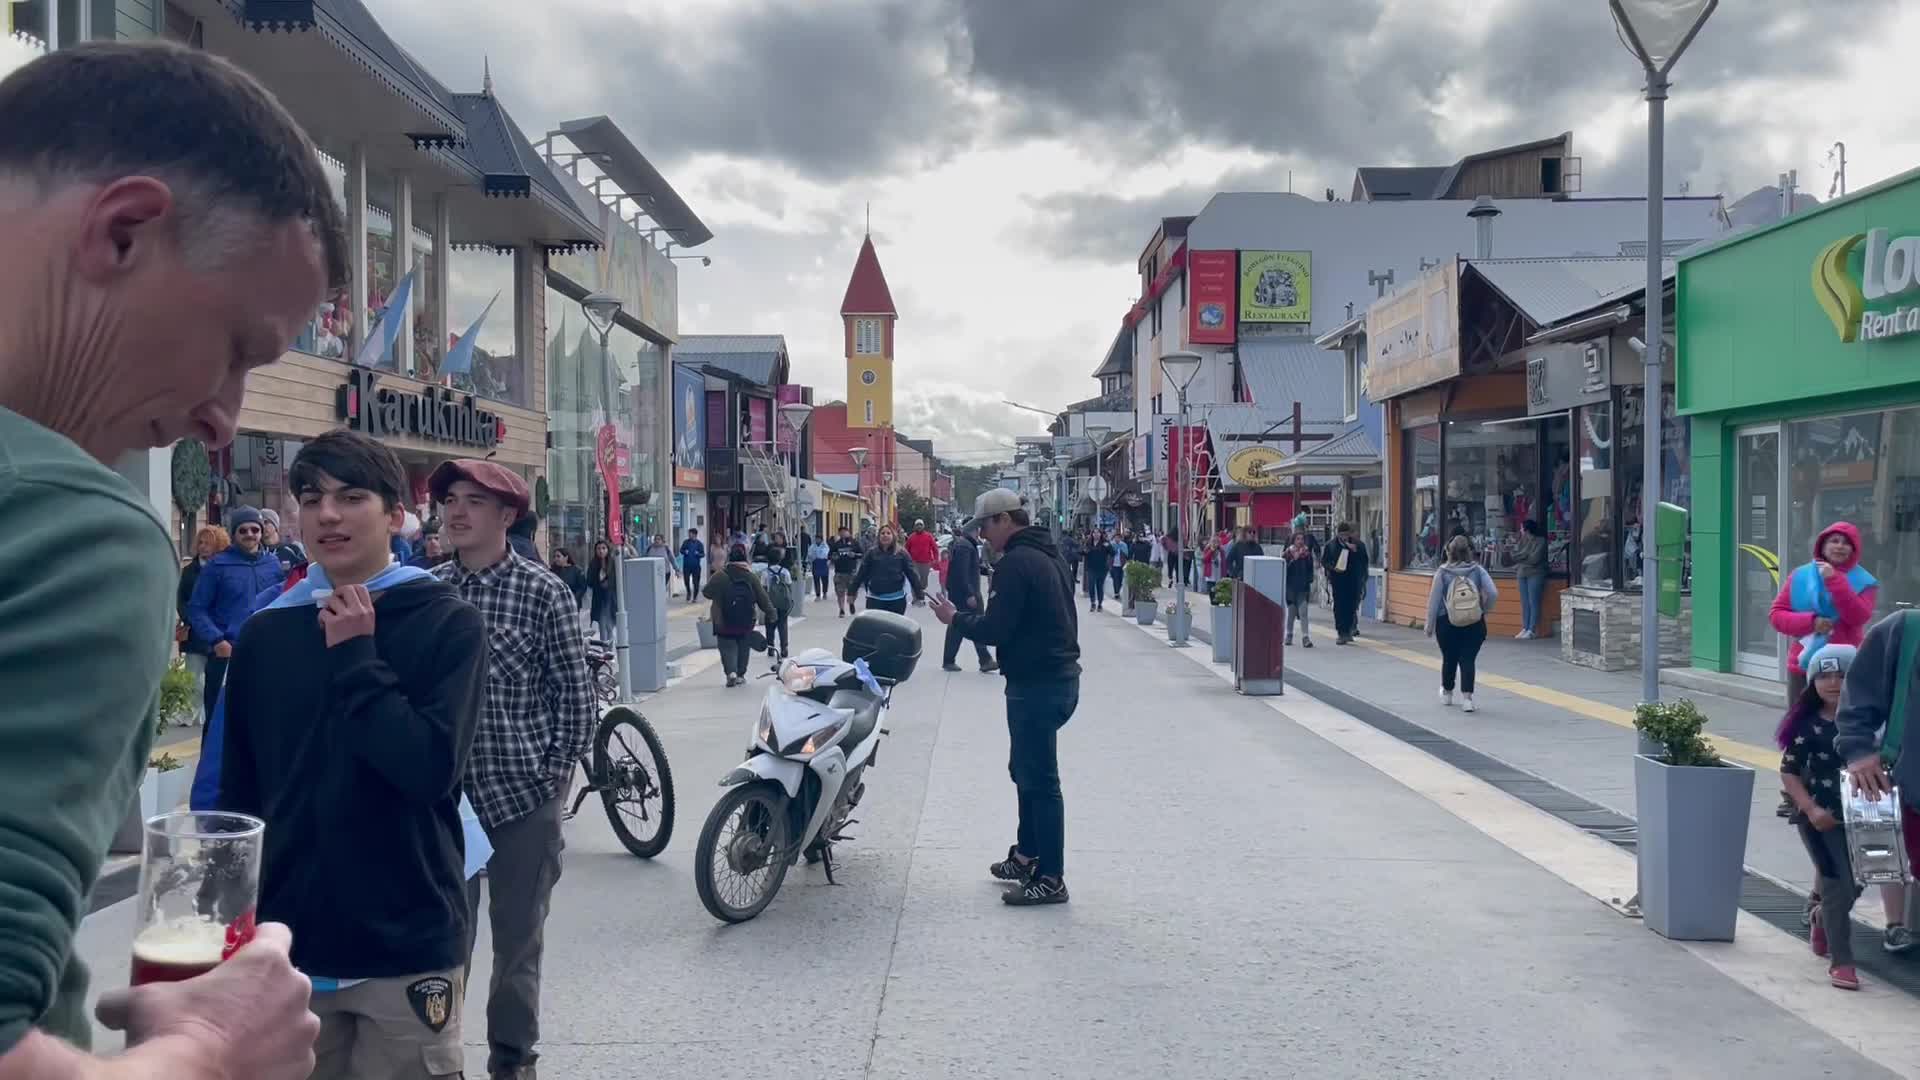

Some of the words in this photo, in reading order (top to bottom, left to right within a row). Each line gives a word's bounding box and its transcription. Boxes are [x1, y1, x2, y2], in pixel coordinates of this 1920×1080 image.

[1244, 309, 1308, 321] RESTAURANT
[1860, 306, 1904, 341] Rent
[353, 370, 497, 449] Karukinka
